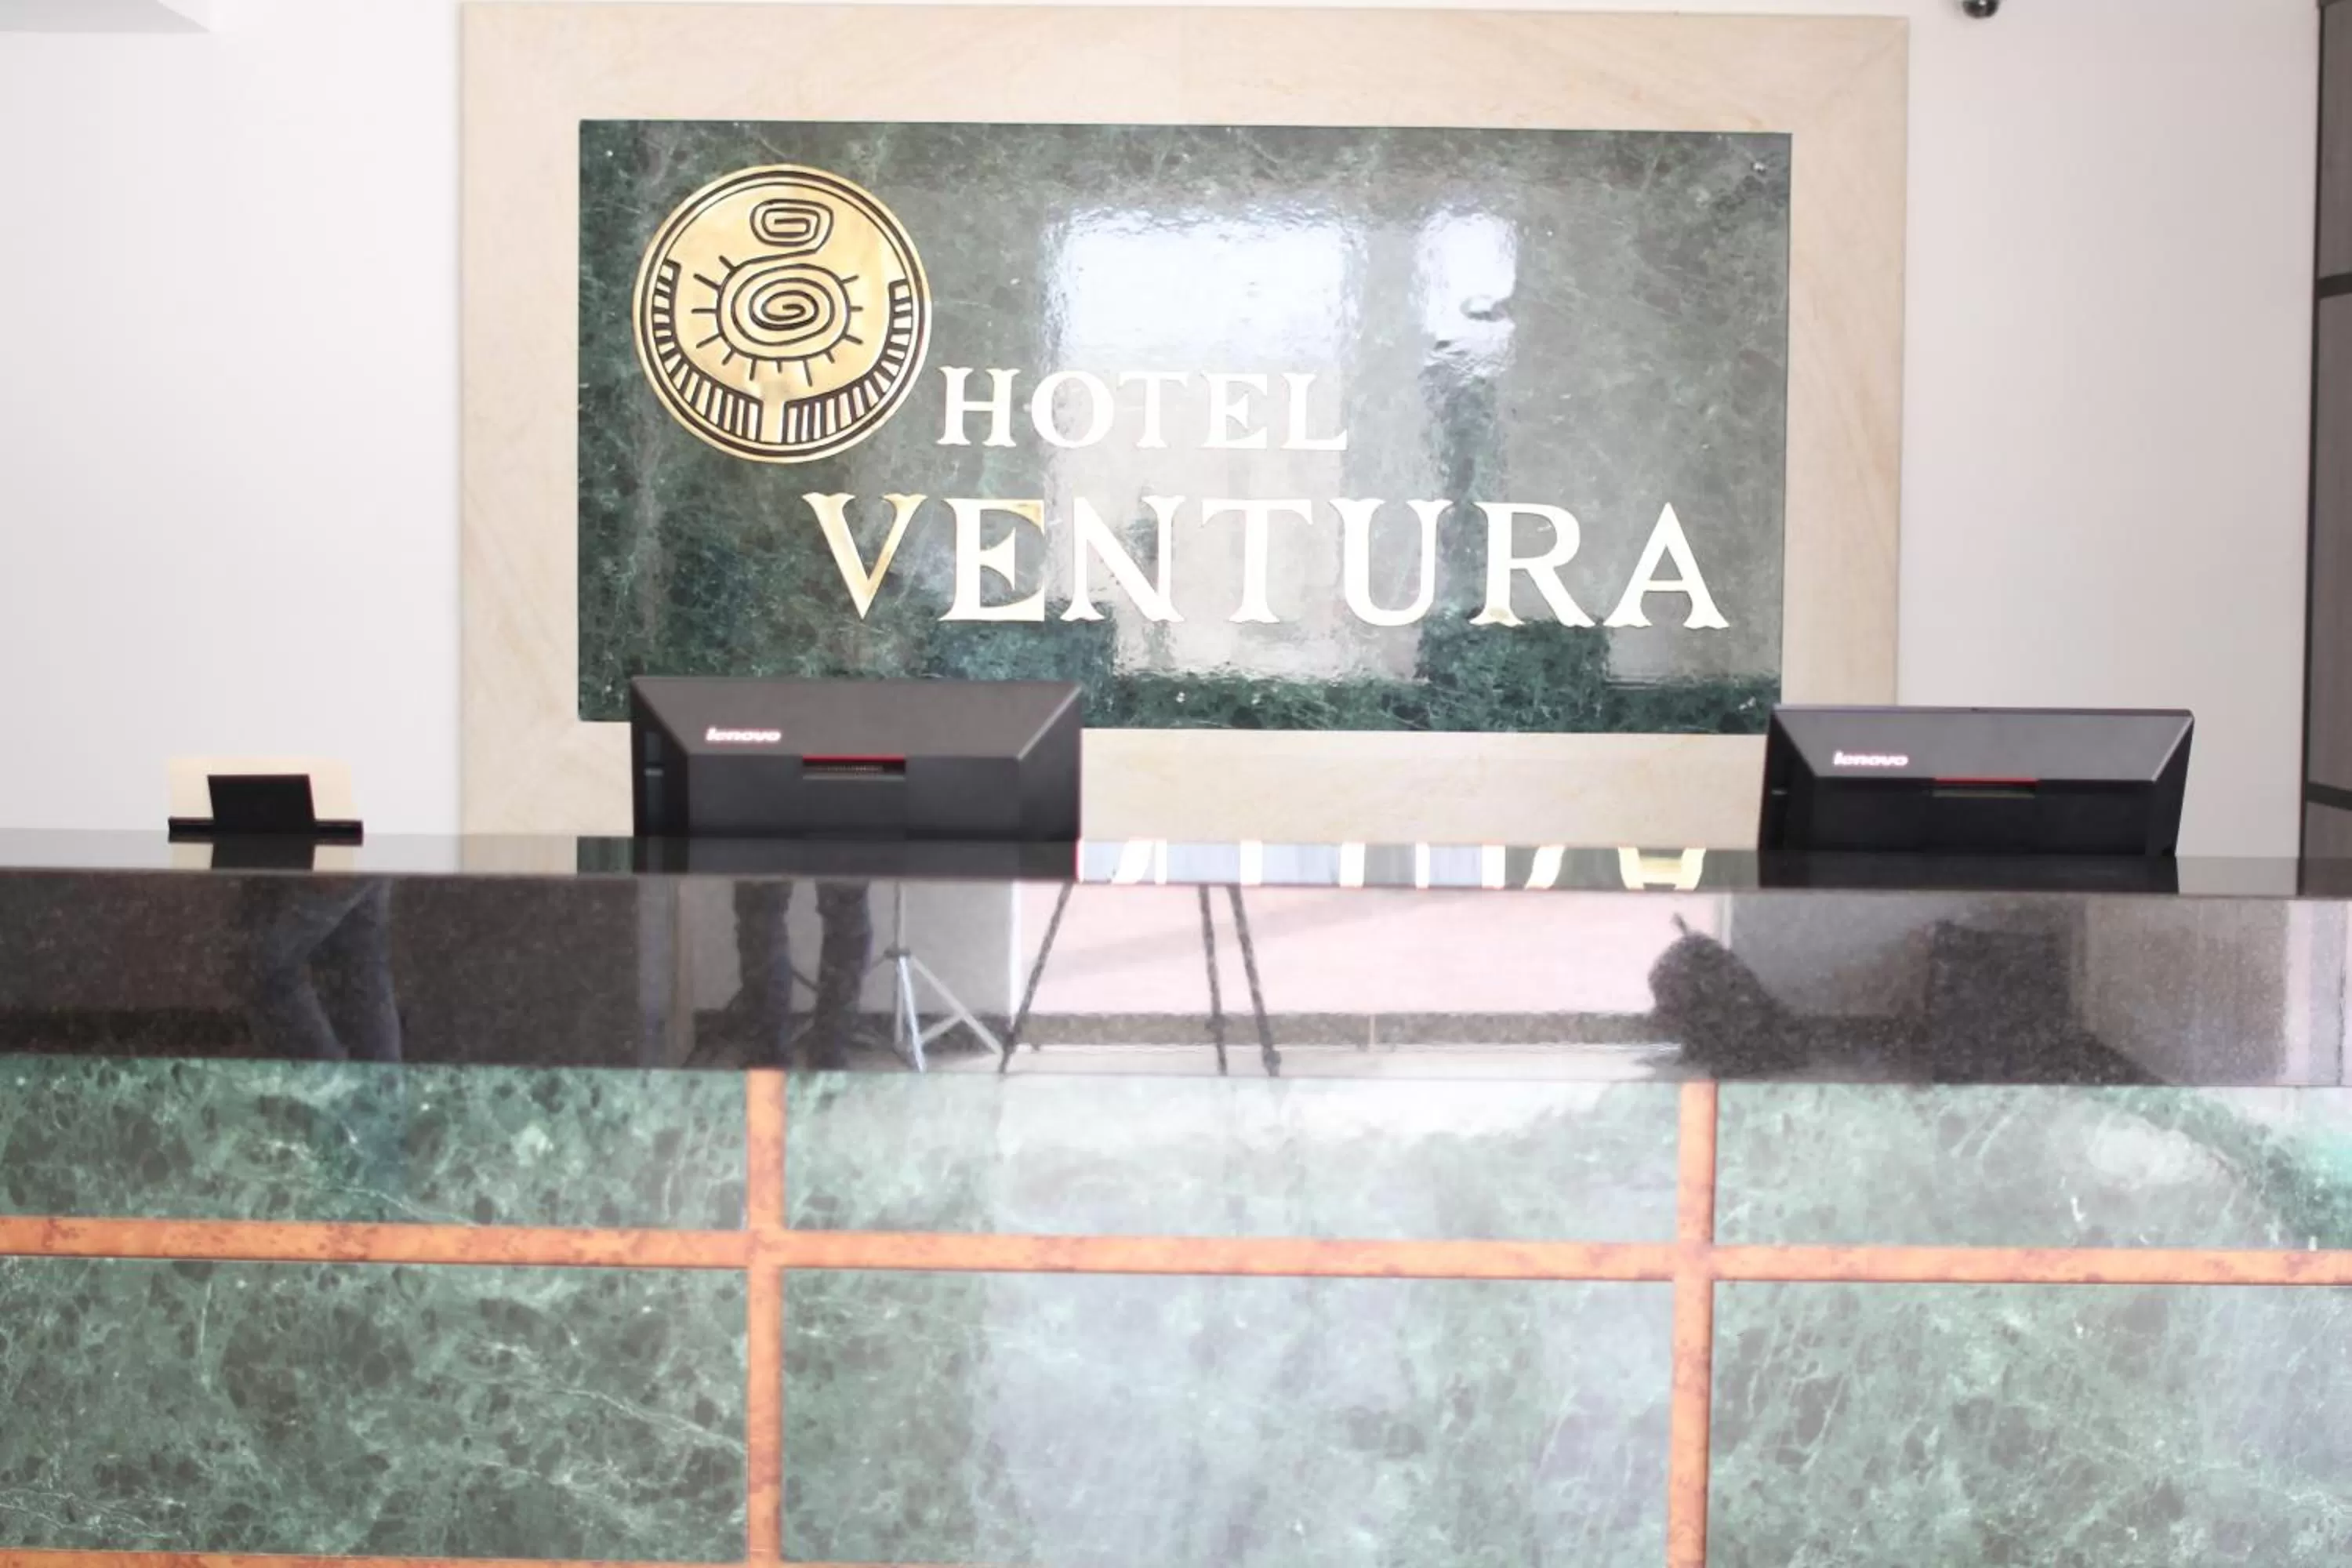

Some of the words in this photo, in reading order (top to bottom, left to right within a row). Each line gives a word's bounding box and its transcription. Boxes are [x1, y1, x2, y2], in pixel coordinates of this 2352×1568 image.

[936, 366, 1348, 452] HOTEL
[803, 492, 1730, 630] VENTURA
[706, 726, 782, 744] lenovo
[1833, 750, 1909, 768] lenovo
